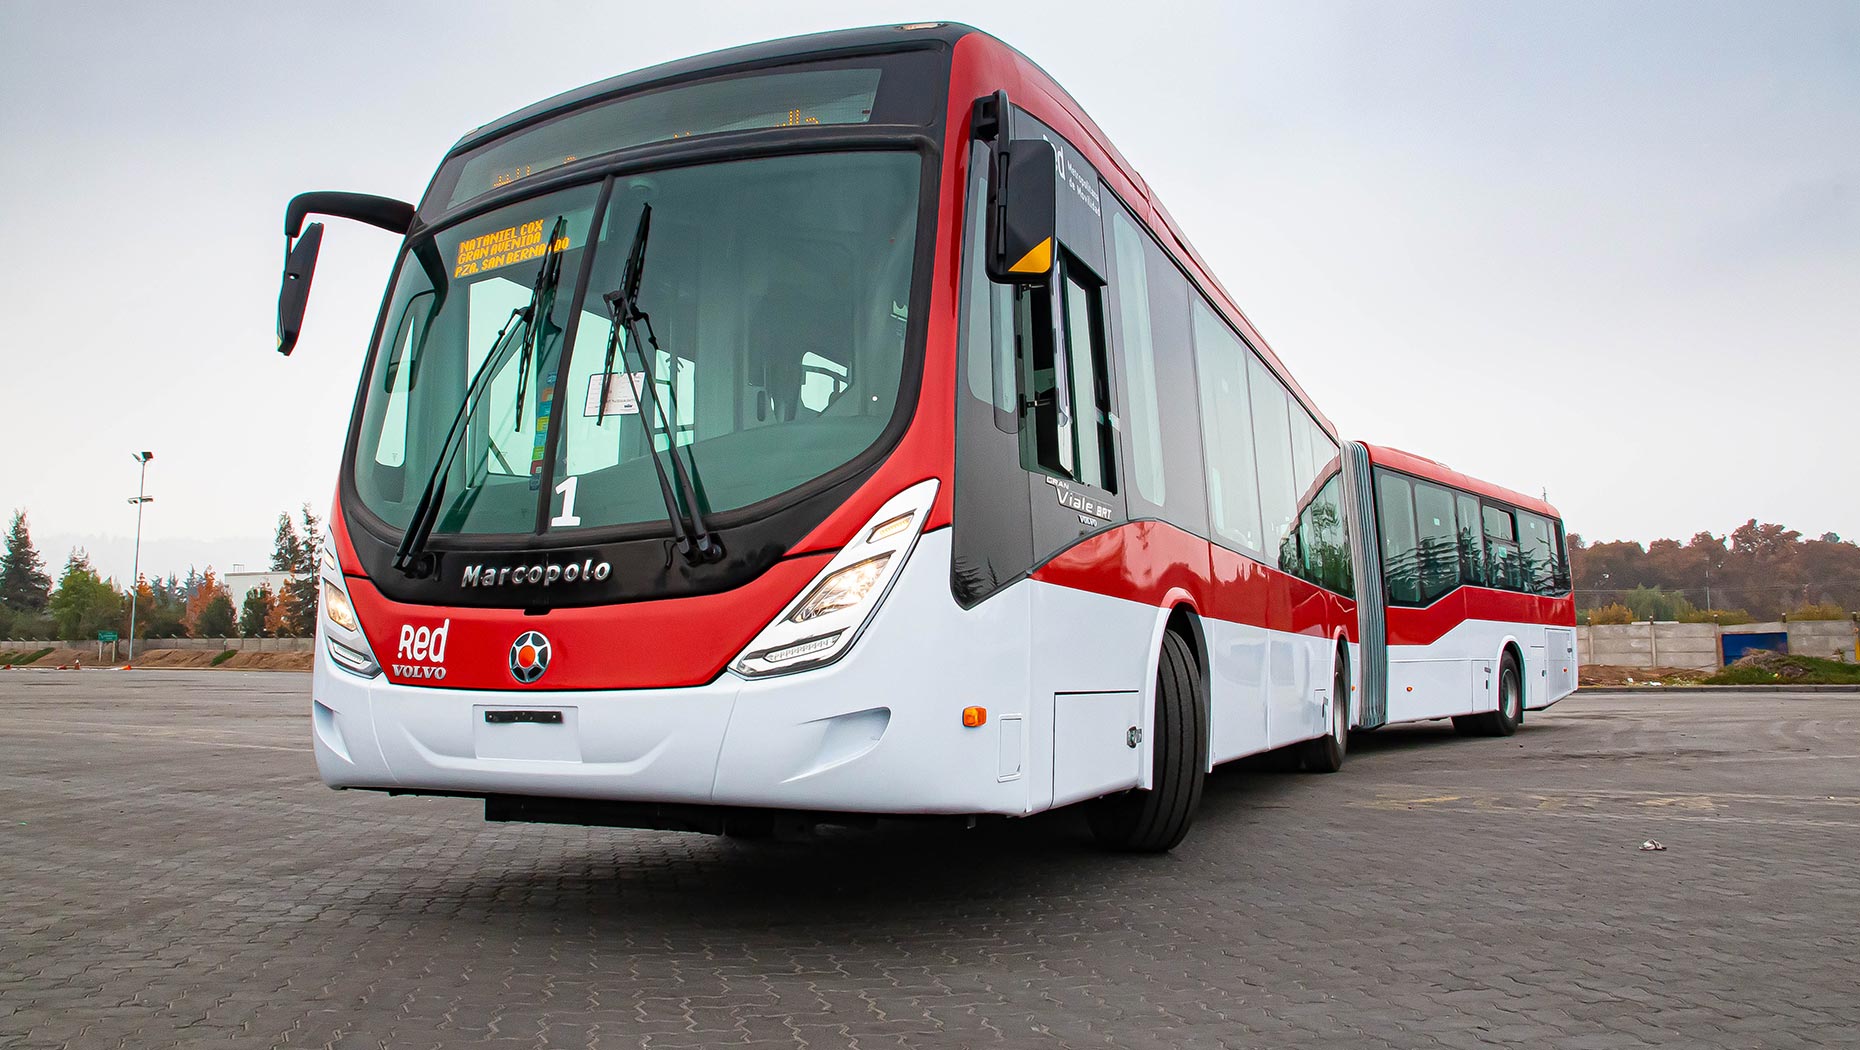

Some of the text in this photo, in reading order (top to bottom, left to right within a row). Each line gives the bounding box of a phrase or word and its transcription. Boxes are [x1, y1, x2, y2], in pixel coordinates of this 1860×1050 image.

[457, 232, 542, 265] GRAN AVENIDA
[459, 219, 544, 253] NATANIEL COX
[454, 236, 570, 279] PZA. SAN BERNADO
[1046, 475, 1070, 490] GRAN
[551, 476, 581, 527] 1
[1057, 487, 1112, 520] Viale BRT
[1078, 514, 1098, 527] VOLVO
[460, 557, 612, 588] Marcopolo
[397, 618, 450, 663] Red
[391, 664, 447, 680] VOLVO
